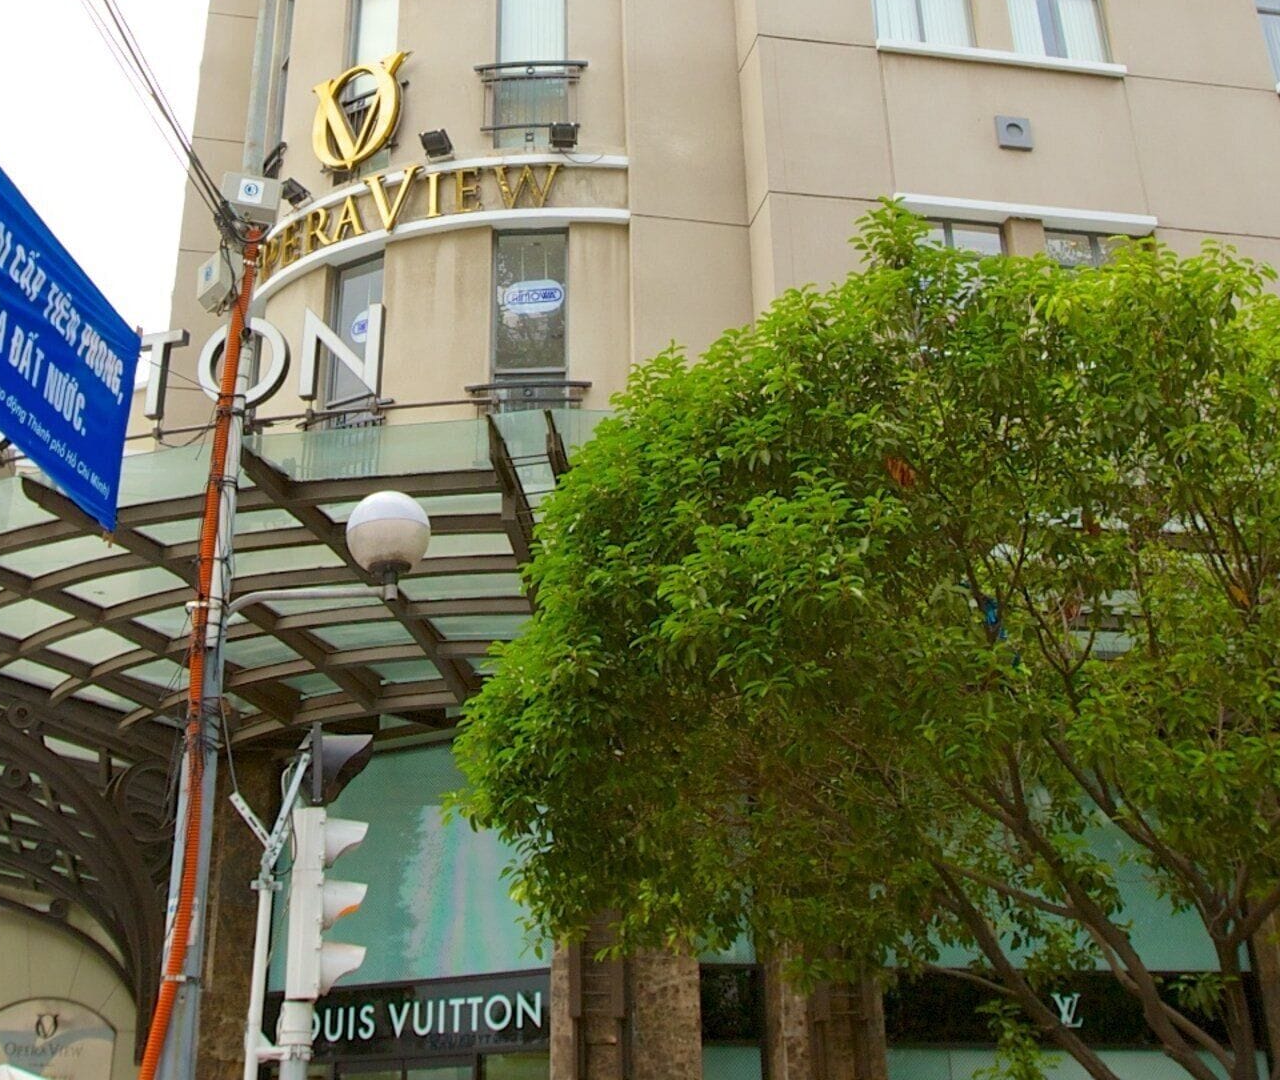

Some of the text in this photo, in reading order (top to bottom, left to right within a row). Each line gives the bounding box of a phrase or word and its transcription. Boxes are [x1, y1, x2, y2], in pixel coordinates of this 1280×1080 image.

[9, 243, 47, 303] CẤP
[77, 322, 124, 406] PHONG,
[6, 394, 26, 424] động
[27, 412, 51, 445] Thành
[8, 325, 45, 389] ĐẤT
[43, 361, 87, 437] NƯỚC.
[389, 991, 542, 1039] VUITTON
